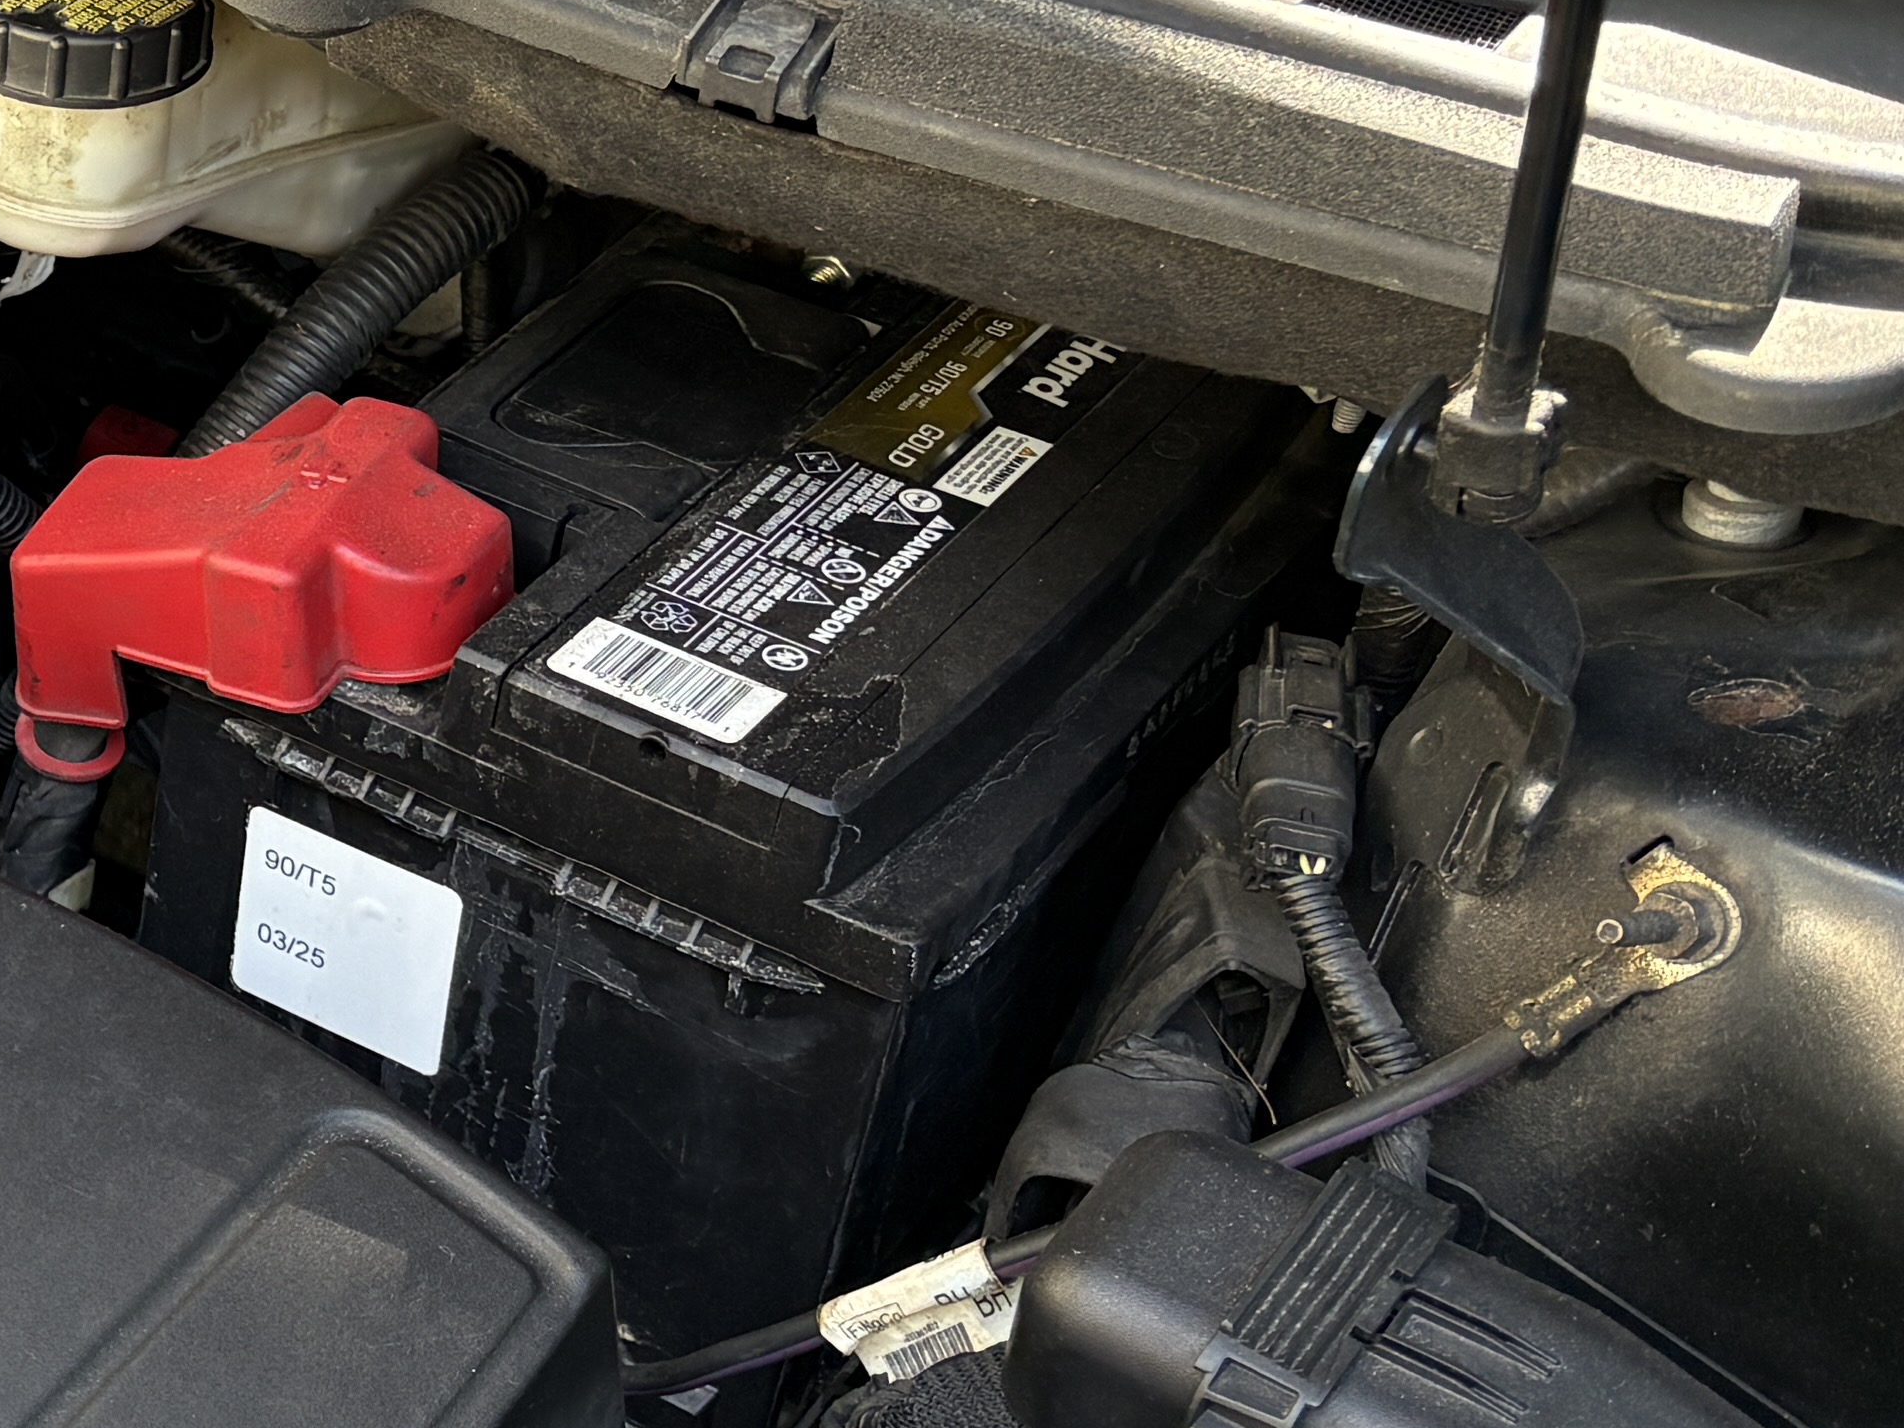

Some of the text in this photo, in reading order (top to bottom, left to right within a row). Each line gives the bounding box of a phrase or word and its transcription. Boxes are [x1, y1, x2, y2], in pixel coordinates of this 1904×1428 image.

[916, 359, 969, 396] 90/T5
[1022, 333, 1128, 408] Hard
[885, 423, 947, 468] GOLD
[977, 454, 1028, 496] WARNING:
[807, 527, 944, 646] DANGER/POISON
[595, 671, 646, 698] 92350
[649, 695, 703, 720] 76817
[264, 848, 337, 897] 90/T5
[257, 922, 326, 970] 03/25
